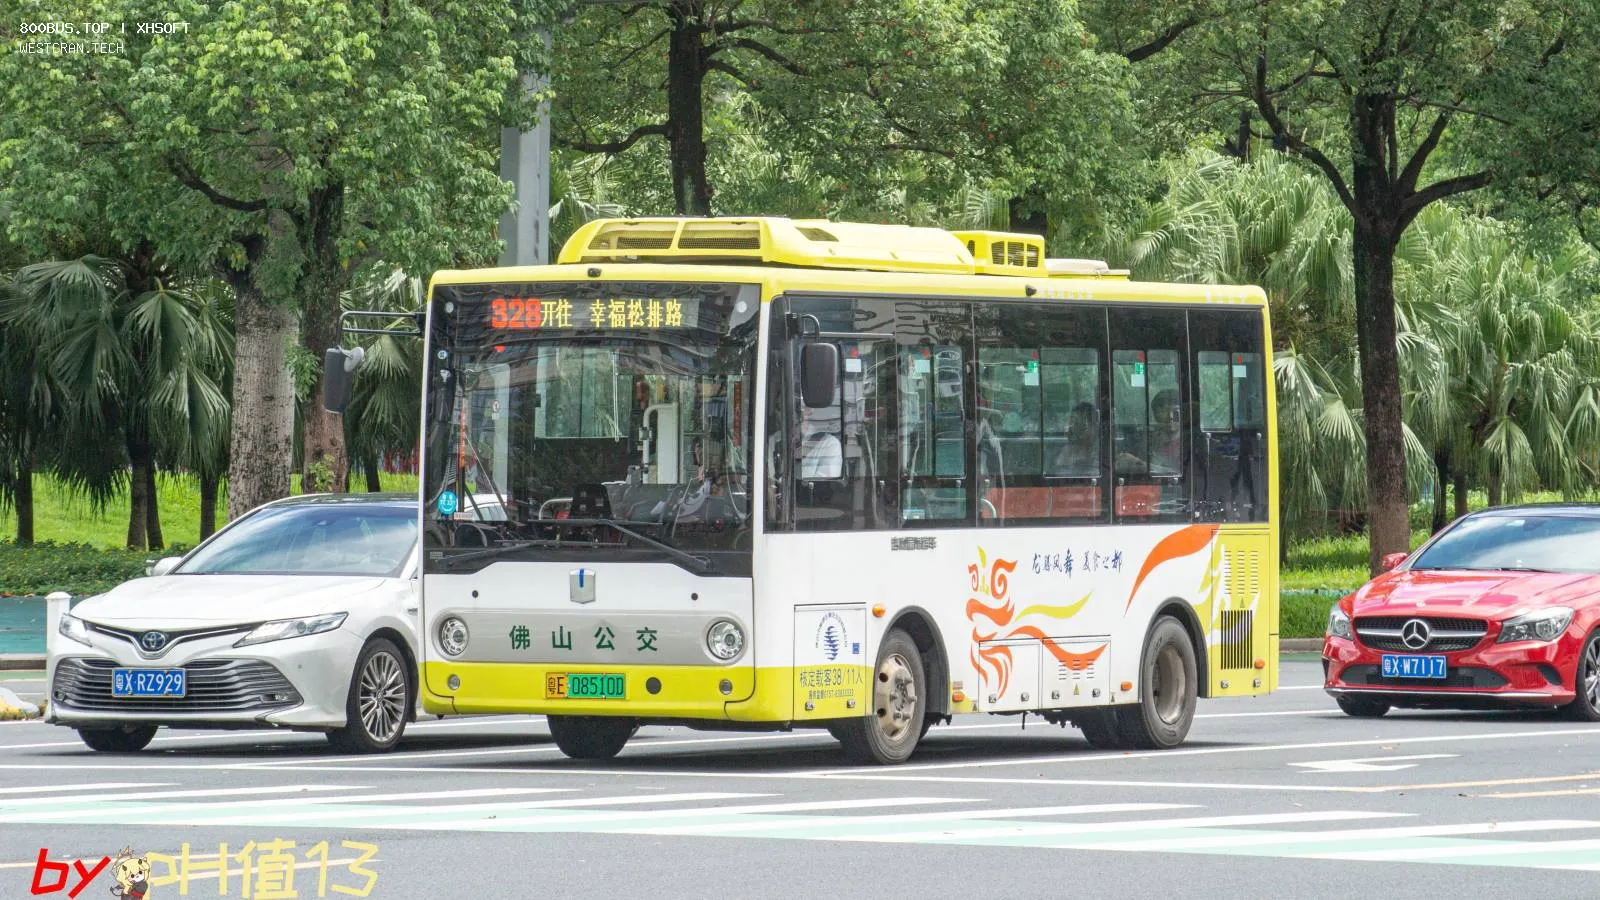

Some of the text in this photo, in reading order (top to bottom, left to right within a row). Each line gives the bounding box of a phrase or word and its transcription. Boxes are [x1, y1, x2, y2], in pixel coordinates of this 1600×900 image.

[491, 297, 683, 329] 328 开往 幸福松排路
[508, 624, 658, 651] 佛山公交
